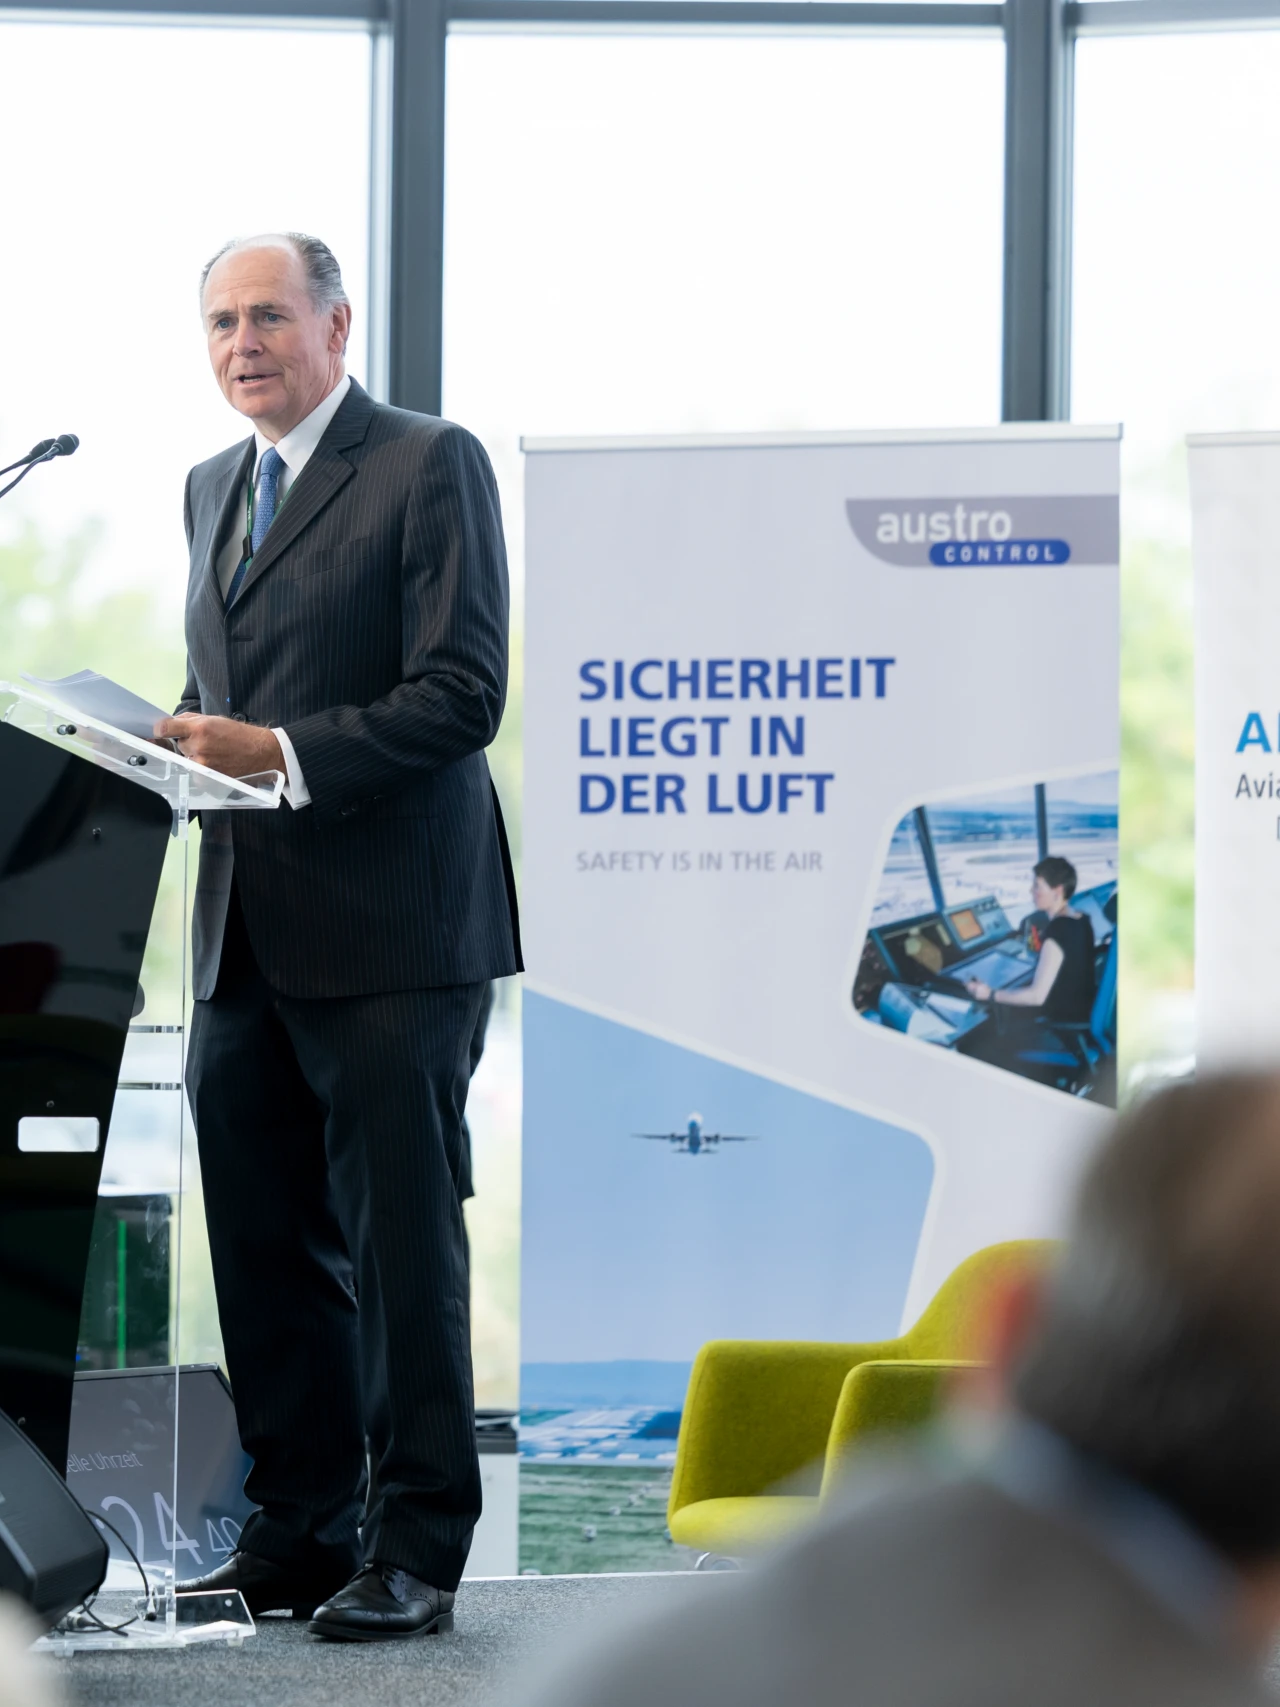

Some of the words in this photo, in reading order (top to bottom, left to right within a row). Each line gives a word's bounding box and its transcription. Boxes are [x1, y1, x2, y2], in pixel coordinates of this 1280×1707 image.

[876, 503, 1012, 544] austro
[944, 544, 1055, 562] CONTROL
[579, 658, 895, 701] SICHERHEIT
[580, 717, 729, 757] LIEGT
[751, 716, 804, 756] IN
[579, 774, 686, 814] DER
[708, 773, 834, 813] LUFT
[577, 851, 664, 872] SAFETY
[672, 851, 692, 872] IS
[699, 851, 722, 871] IN
[731, 851, 775, 871] THE
[784, 850, 823, 871] AIR
[67, 1453, 93, 1473] elle
[89, 1450, 144, 1470] Uhrzeit
